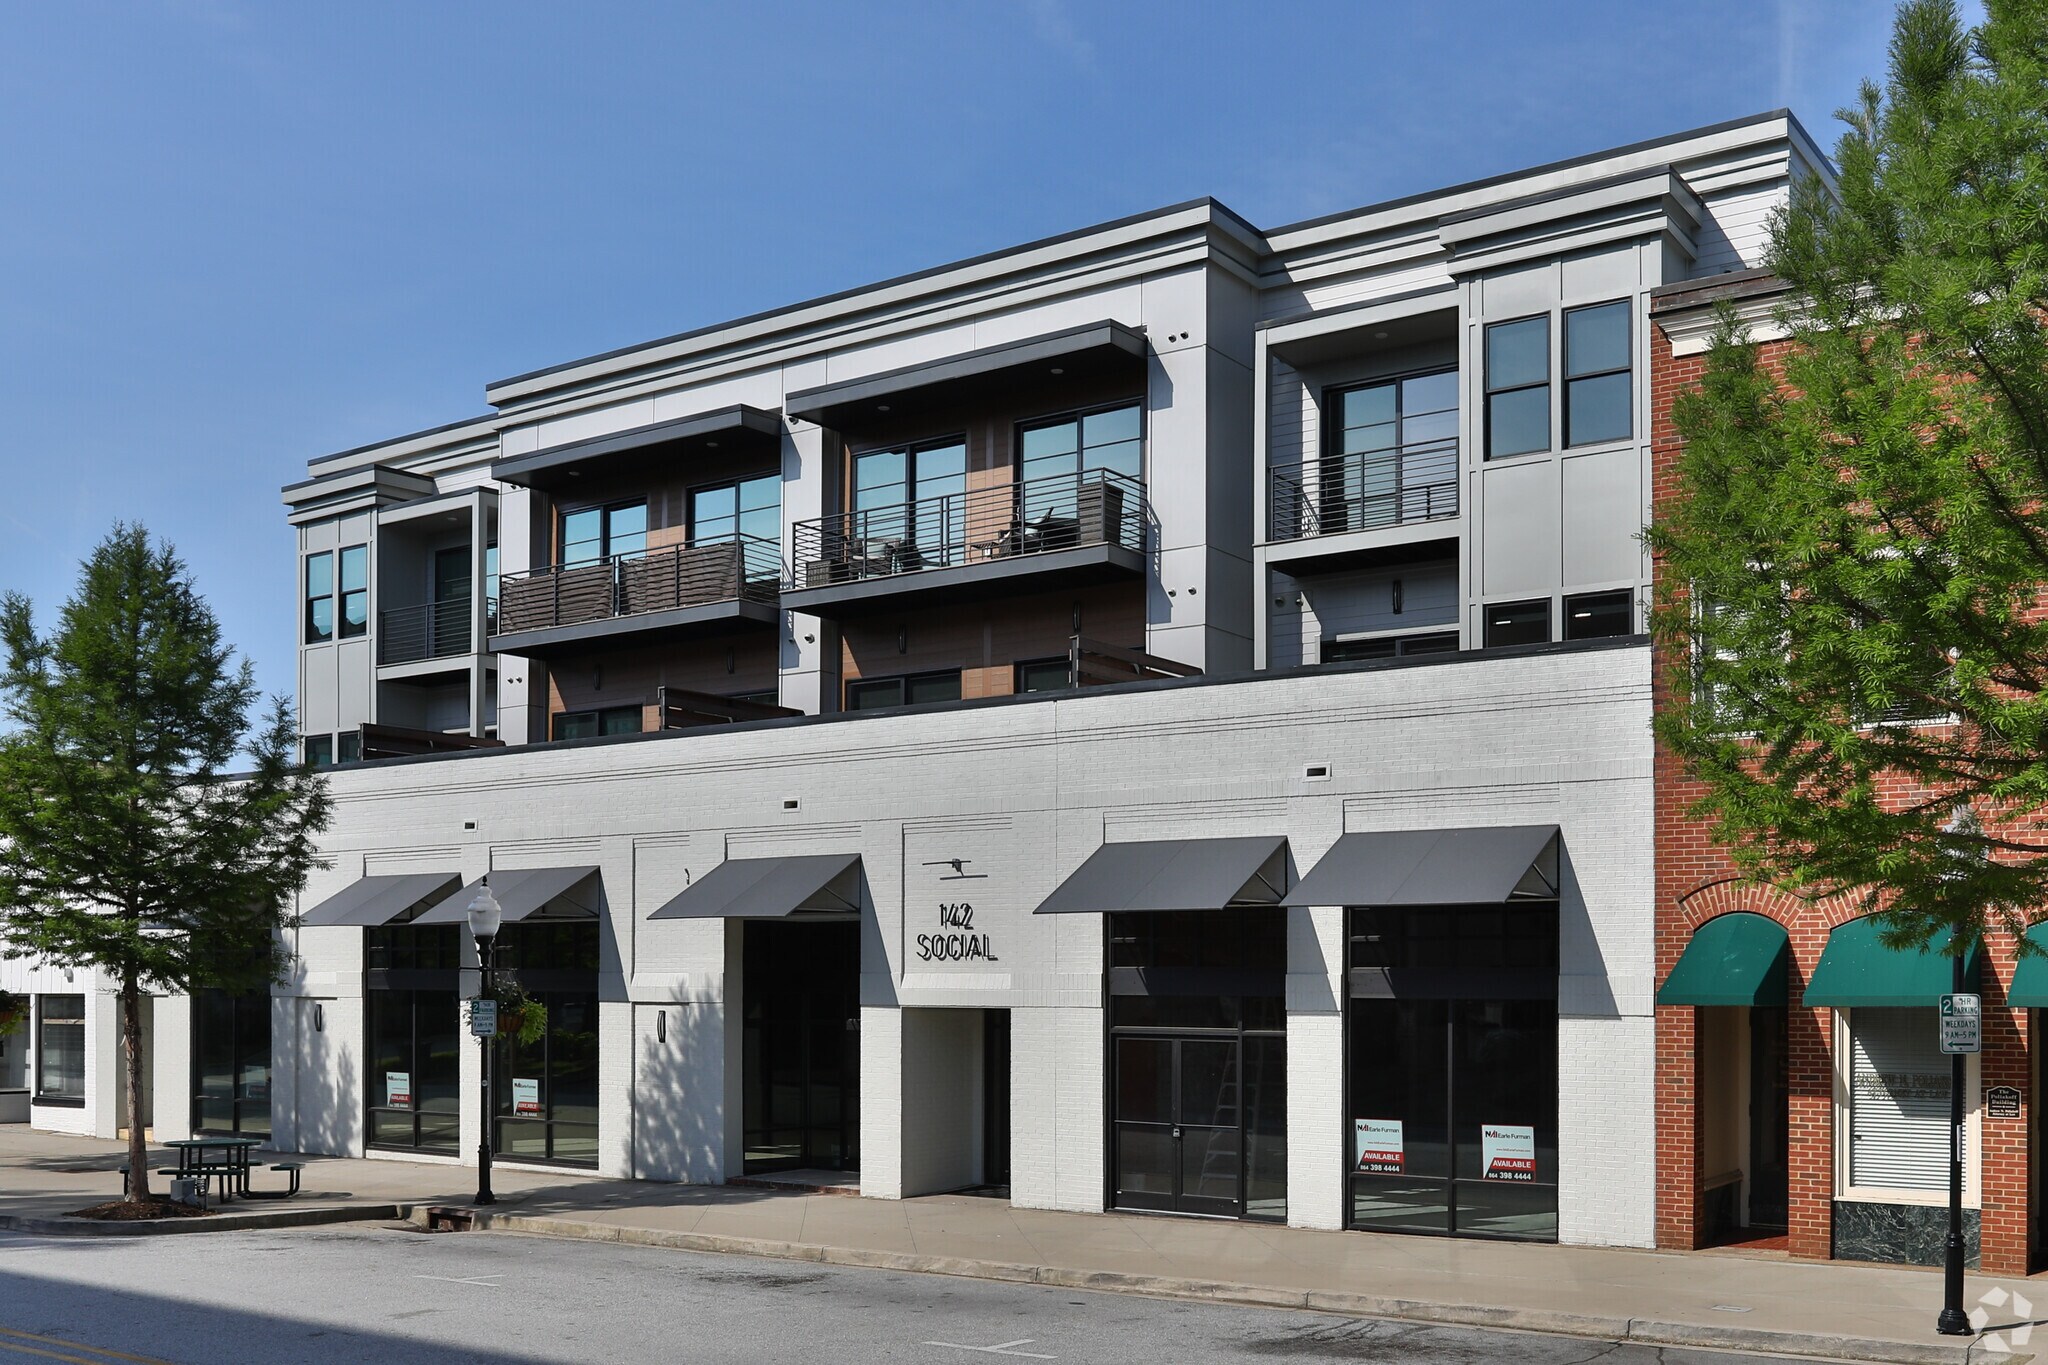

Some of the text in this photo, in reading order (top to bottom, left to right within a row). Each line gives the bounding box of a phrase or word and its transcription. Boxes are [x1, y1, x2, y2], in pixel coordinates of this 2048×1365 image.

[939, 903, 973, 930] 142
[916, 933, 998, 961] SOCIAL
[473, 1003, 479, 1013] 2
[1943, 998, 1972, 1014] 2 HR
[1953, 1006, 1978, 1015] PARKING
[1945, 1020, 1976, 1029] WEEKDAYS
[1364, 1152, 1400, 1161] AVAILABLE
[1370, 1163, 1382, 1171] 398
[1383, 1164, 1400, 1172] 4444
[1492, 1159, 1532, 1169] AVAILABLE
[1499, 1171, 1512, 1179] 398
[1513, 1172, 1531, 1180] 4444
